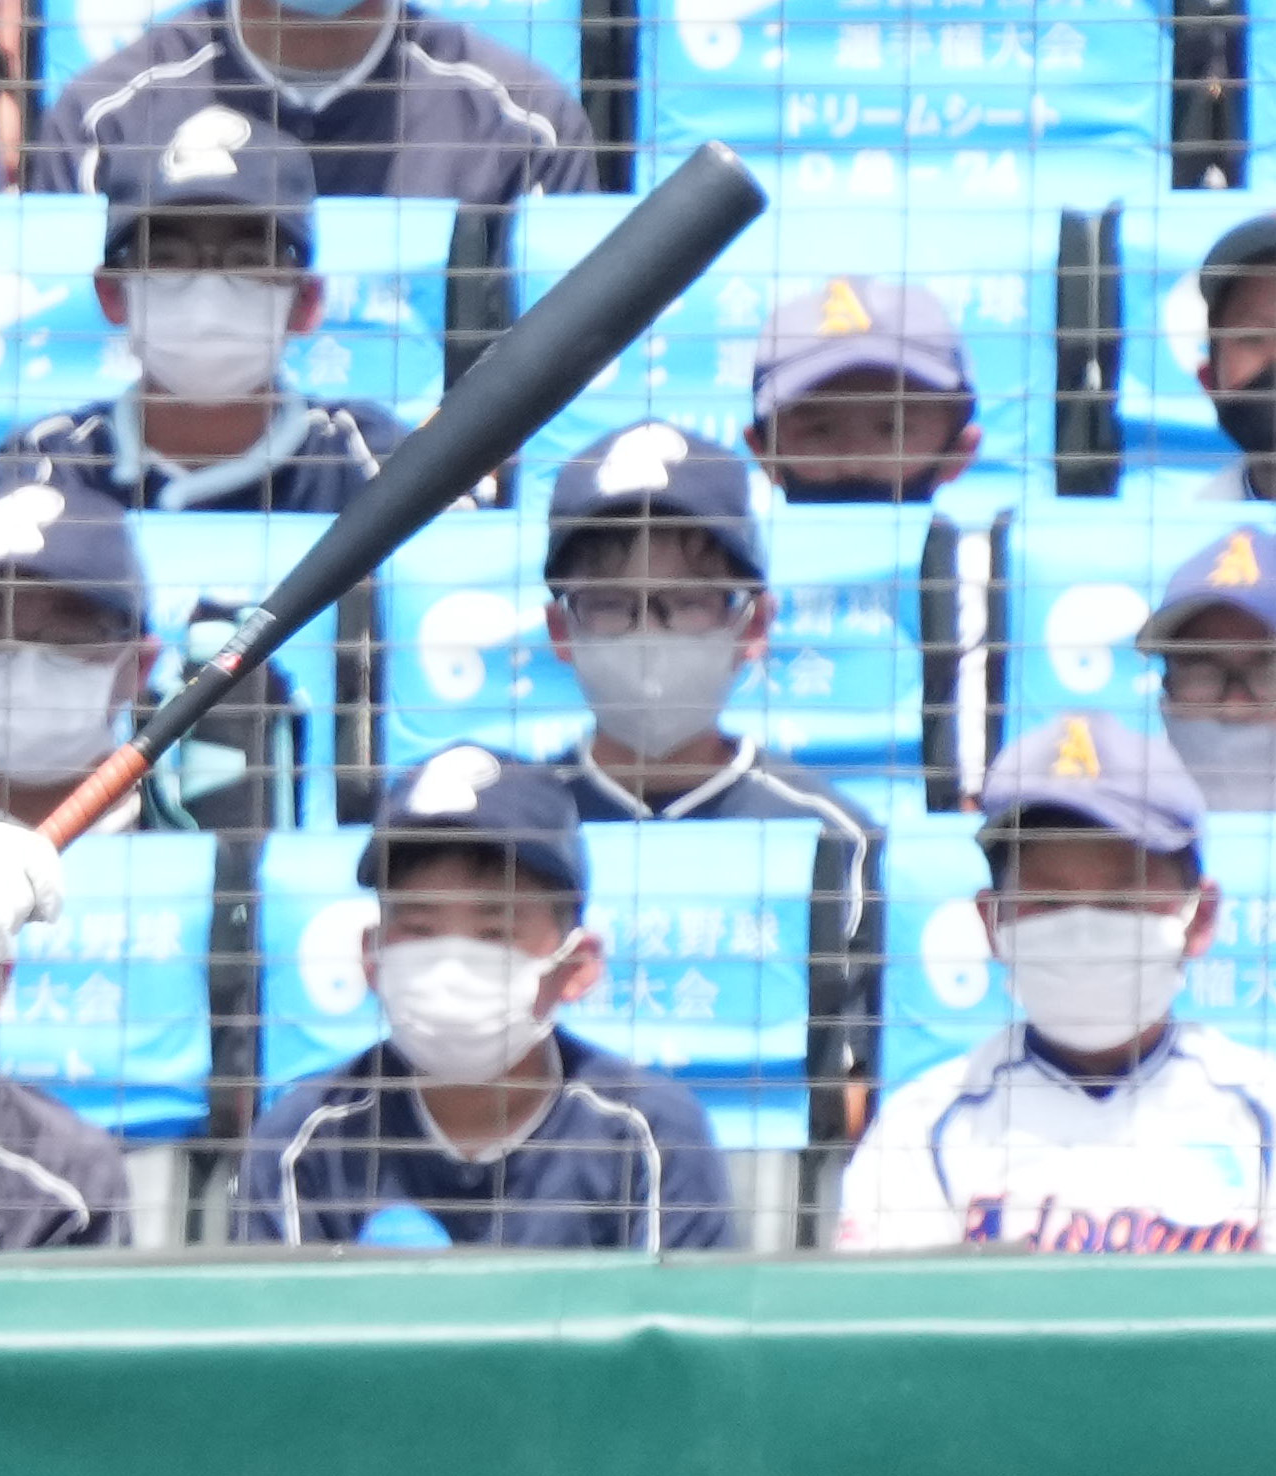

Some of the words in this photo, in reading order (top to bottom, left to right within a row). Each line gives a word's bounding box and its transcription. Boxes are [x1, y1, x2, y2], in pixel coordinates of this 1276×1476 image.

[788, 93, 1060, 139] ドリームシート
[1206, 534, 1261, 587] A
[1051, 713, 1101, 781] A
